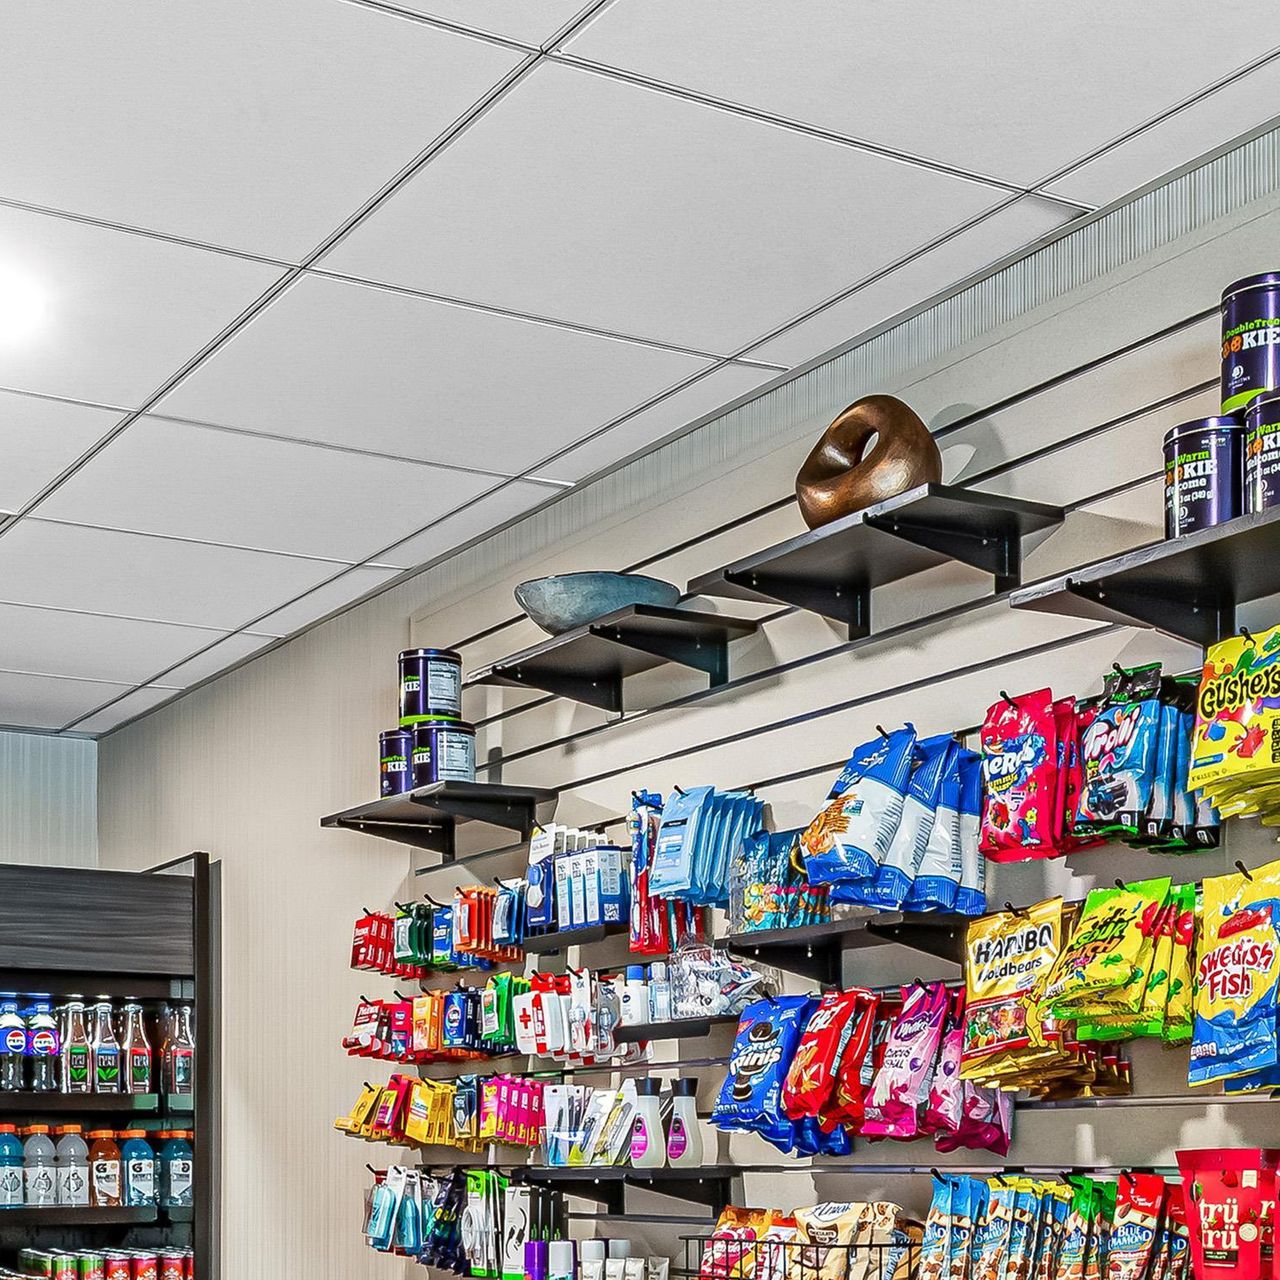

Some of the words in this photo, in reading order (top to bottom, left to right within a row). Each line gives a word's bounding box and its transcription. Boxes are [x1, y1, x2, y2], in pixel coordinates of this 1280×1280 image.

[1226, 317, 1280, 339] DoubleTree
[1177, 449, 1210, 464] Warm
[1083, 706, 1142, 760] Trolli
[974, 924, 1053, 964] HARIBO
[1073, 920, 1129, 949] SOUR
[1199, 1198, 1239, 1224] trü
[1117, 1225, 1142, 1238] BLUE
[1201, 1223, 1239, 1250] frü
